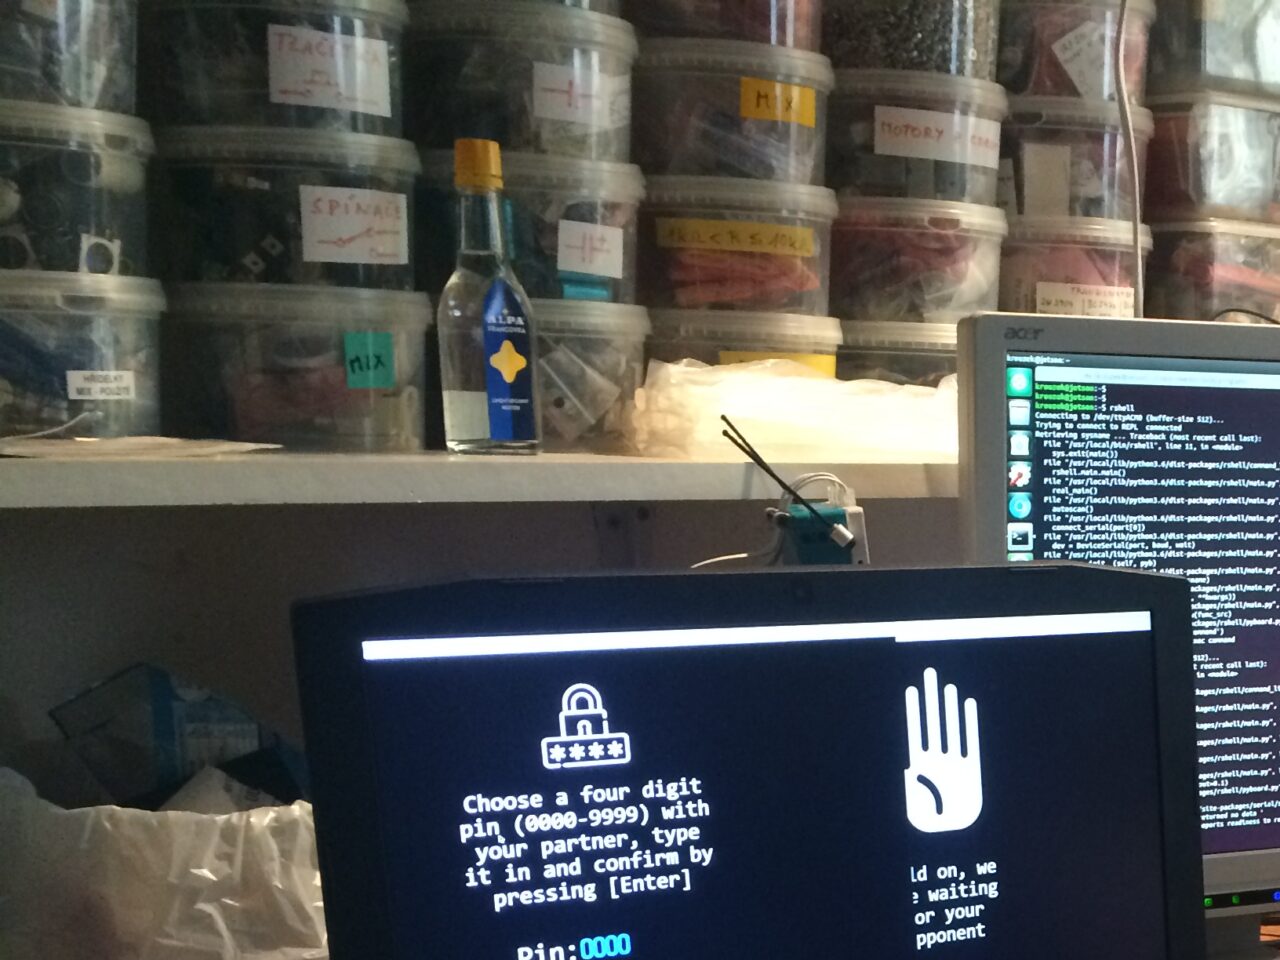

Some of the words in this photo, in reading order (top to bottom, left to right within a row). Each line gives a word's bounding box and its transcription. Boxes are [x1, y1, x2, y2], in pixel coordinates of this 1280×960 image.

[486, 315, 526, 325] ALPA
[1004, 327, 1044, 340] acer
[349, 353, 385, 375] MIX
[1109, 403, 1135, 411] rshell
[1035, 411, 1078, 422] Connecting
[1081, 412, 1091, 420] to
[1145, 414, 1194, 424] (buffer-size
[1035, 421, 1062, 430] Trying
[1064, 421, 1074, 429] to
[1076, 422, 1107, 430] connect
[1110, 422, 1120, 430] to
[1121, 422, 1139, 430] REPL
[1145, 423, 1182, 431] connected
[1035, 430, 1078, 440] Retrieving
[1129, 432, 1166, 440] Traceback
[1169, 433, 1190, 443] (most
[1193, 433, 1217, 441] recent
[1219, 433, 1235, 441] call
[1238, 434, 1262, 444] last):
[1165, 442, 1182, 450] line
[1211, 443, 1244, 451] <module>
[1044, 458, 1061, 466] File
[1052, 468, 1126, 478] rshell.main.main()
[1052, 486, 1098, 496] real_main()
[1044, 495, 1061, 503] File
[1052, 505, 1094, 515] autoscan()
[1044, 514, 1061, 522] File
[1044, 532, 1061, 540] File
[1052, 541, 1065, 549] dev
[1208, 636, 1236, 644] command
[1200, 661, 1224, 669] recent
[1245, 660, 1268, 669] last):
[1196, 670, 1205, 678] in
[463, 793, 543, 814] Choose
[555, 792, 568, 806] a
[580, 785, 630, 804] four
[642, 777, 702, 800] digit
[1241, 810, 1257, 818] data
[459, 818, 500, 843] pin
[514, 804, 649, 838] (0000-9999)
[661, 799, 710, 820] with
[1227, 817, 1260, 827] readiness
[1263, 816, 1271, 824] to
[474, 841, 528, 866] your
[540, 832, 639, 859] partner,
[652, 825, 700, 847] type
[465, 867, 491, 887] it
[505, 863, 530, 883] in
[543, 857, 581, 879] and
[594, 849, 679, 874] confirm
[689, 846, 714, 866] by
[910, 865, 928, 882] ld
[937, 865, 965, 880] on,
[976, 861, 997, 875] we
[493, 881, 597, 912] pressing
[609, 868, 691, 900] [Enter]
[928, 881, 999, 902] waiting
[914, 910, 935, 925] or
[945, 904, 985, 925] your
[916, 923, 986, 950] pponent
